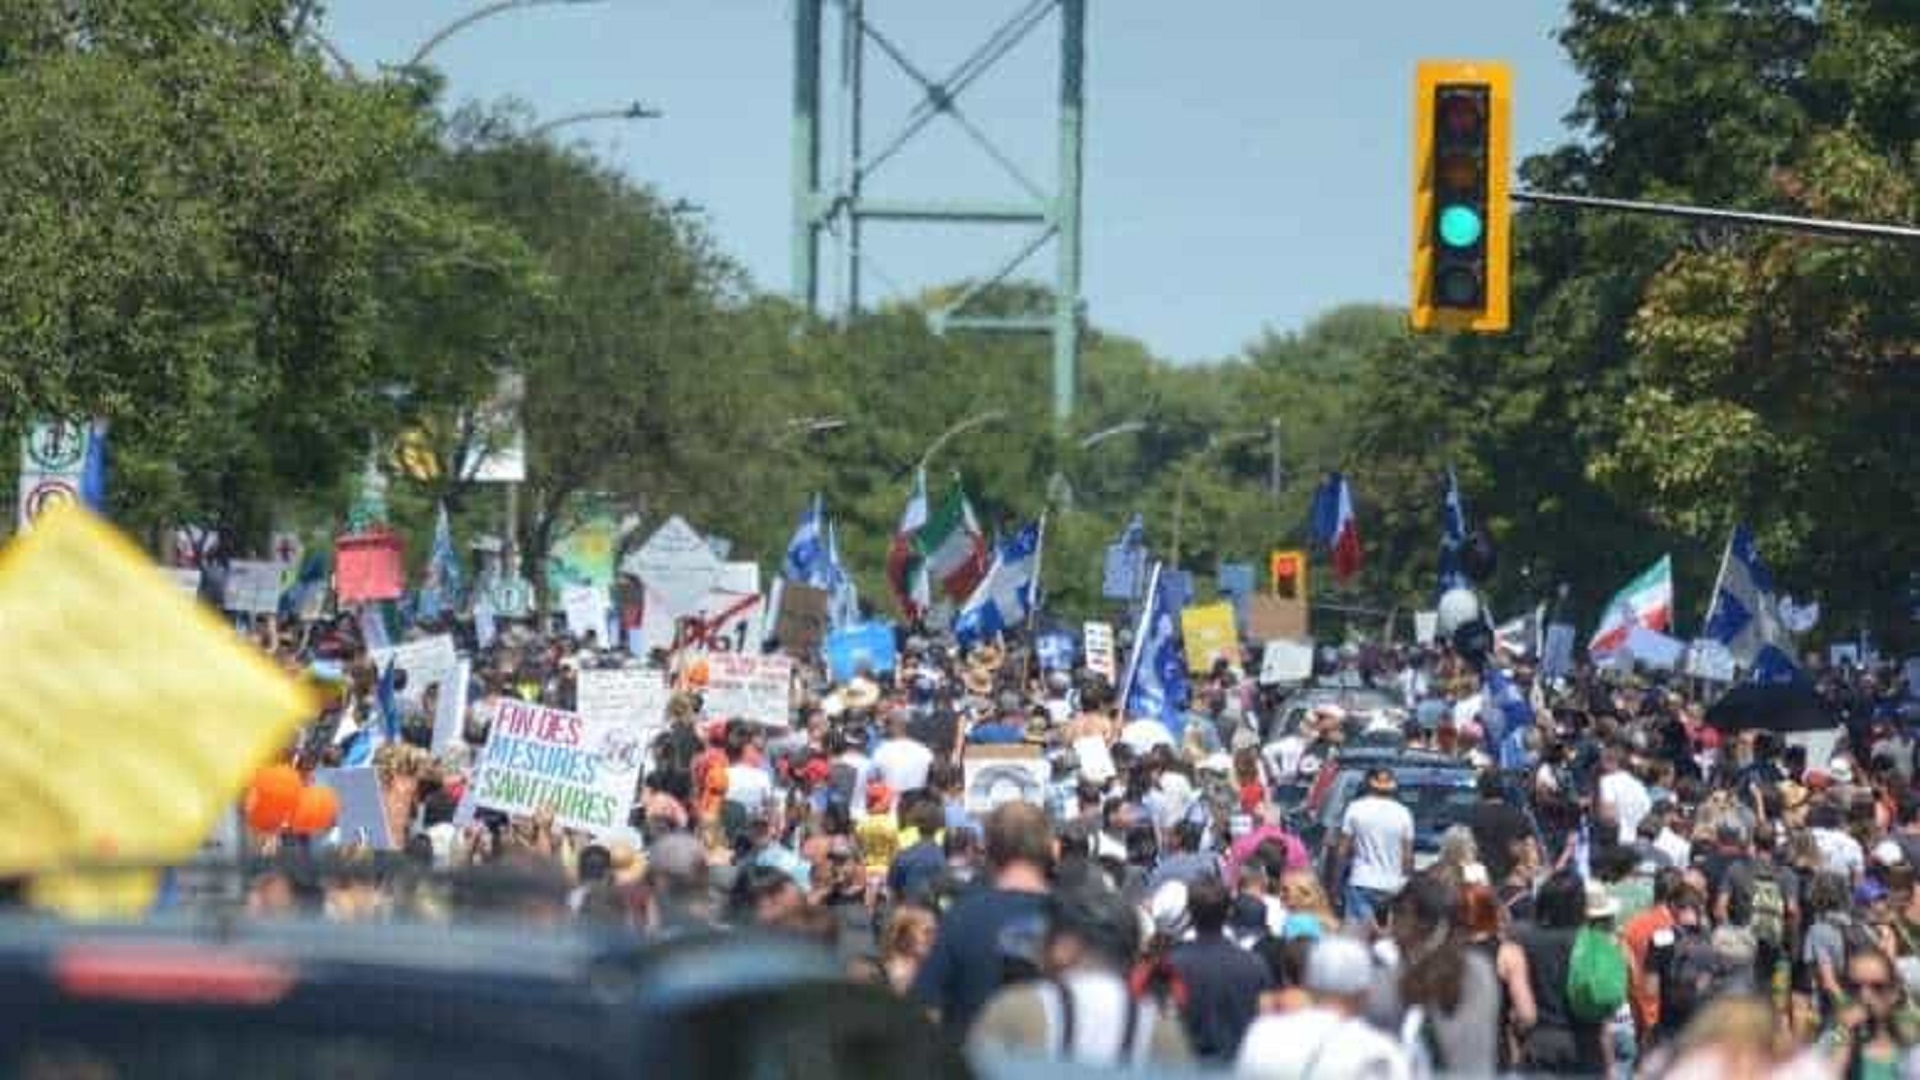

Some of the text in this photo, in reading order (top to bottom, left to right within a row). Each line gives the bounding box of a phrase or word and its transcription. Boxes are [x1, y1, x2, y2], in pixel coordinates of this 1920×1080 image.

[497, 702, 583, 746] FIN DES
[489, 735, 599, 785] MESURES
[480, 768, 618, 827] SANITAIRES
